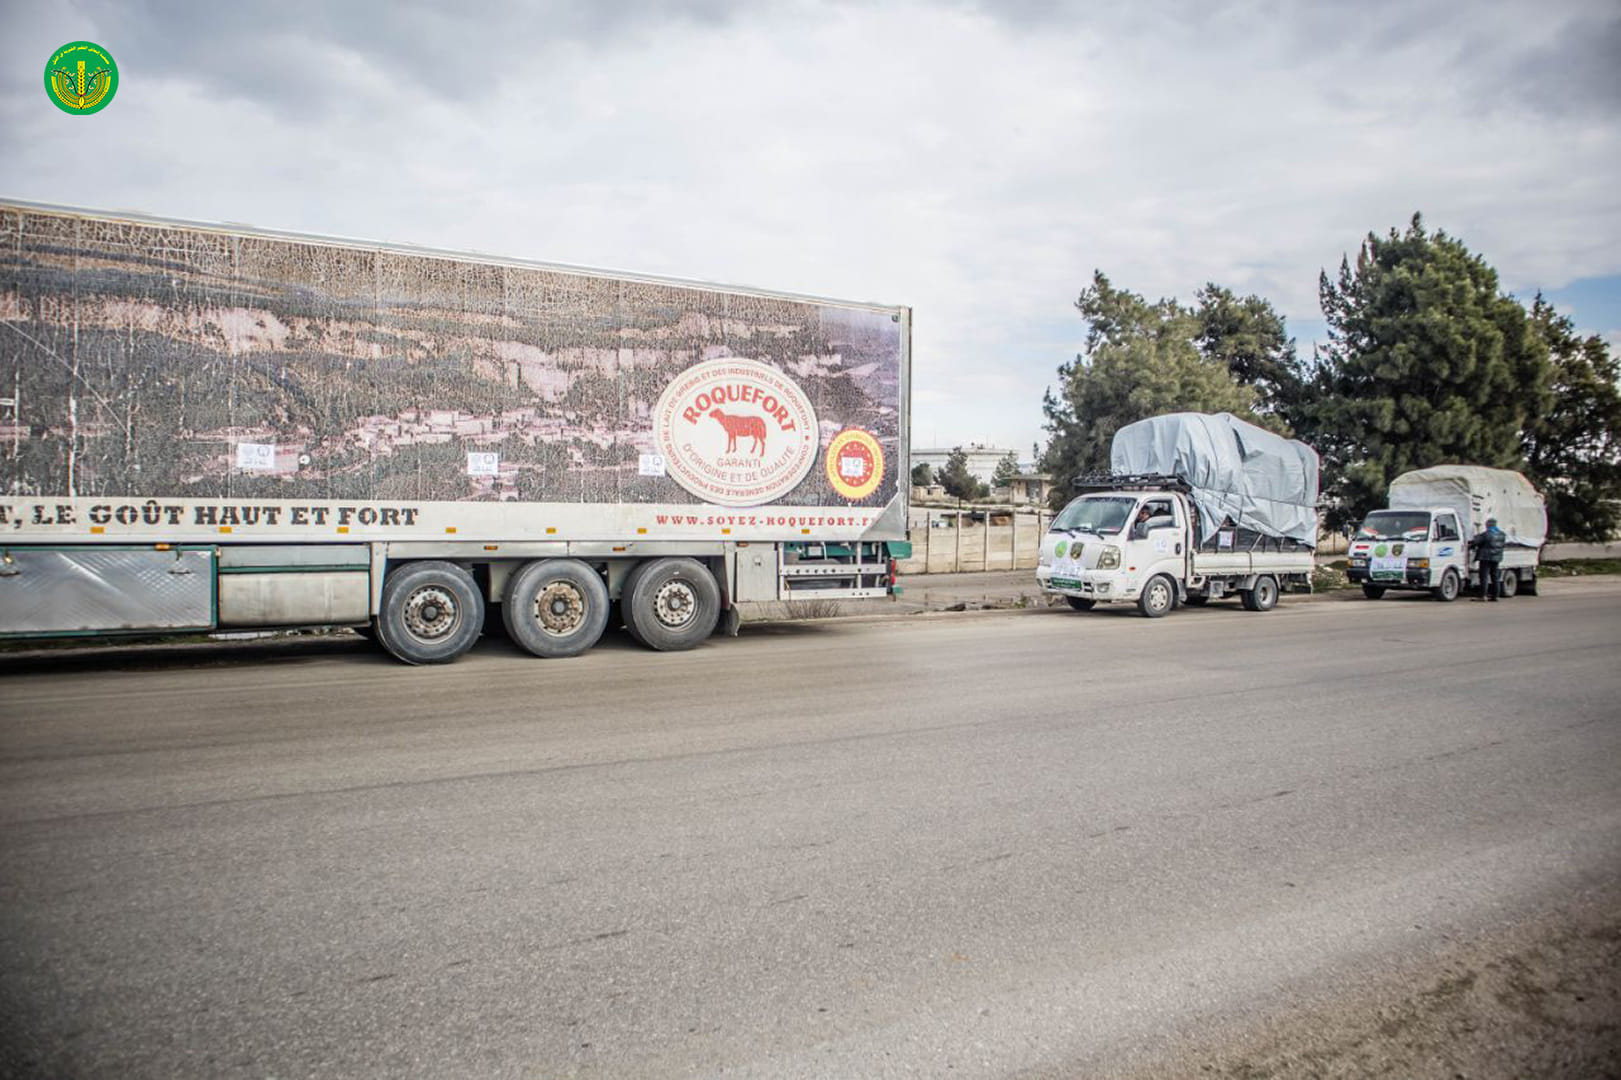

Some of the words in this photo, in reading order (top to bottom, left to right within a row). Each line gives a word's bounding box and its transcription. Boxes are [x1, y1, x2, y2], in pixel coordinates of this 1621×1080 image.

[683, 384, 796, 432] ROQUEFORT
[717, 458, 761, 467] GARANTI
[730, 473, 741, 482] ET
[745, 472, 758, 481] DE
[32, 505, 76, 524] LE
[89, 500, 184, 525] GOÛT
[194, 506, 281, 525] HAUT
[291, 507, 330, 525] ET
[338, 507, 418, 526] FORT
[656, 515, 873, 527] WWW.SOYEZ-ROQUEFORT.F
